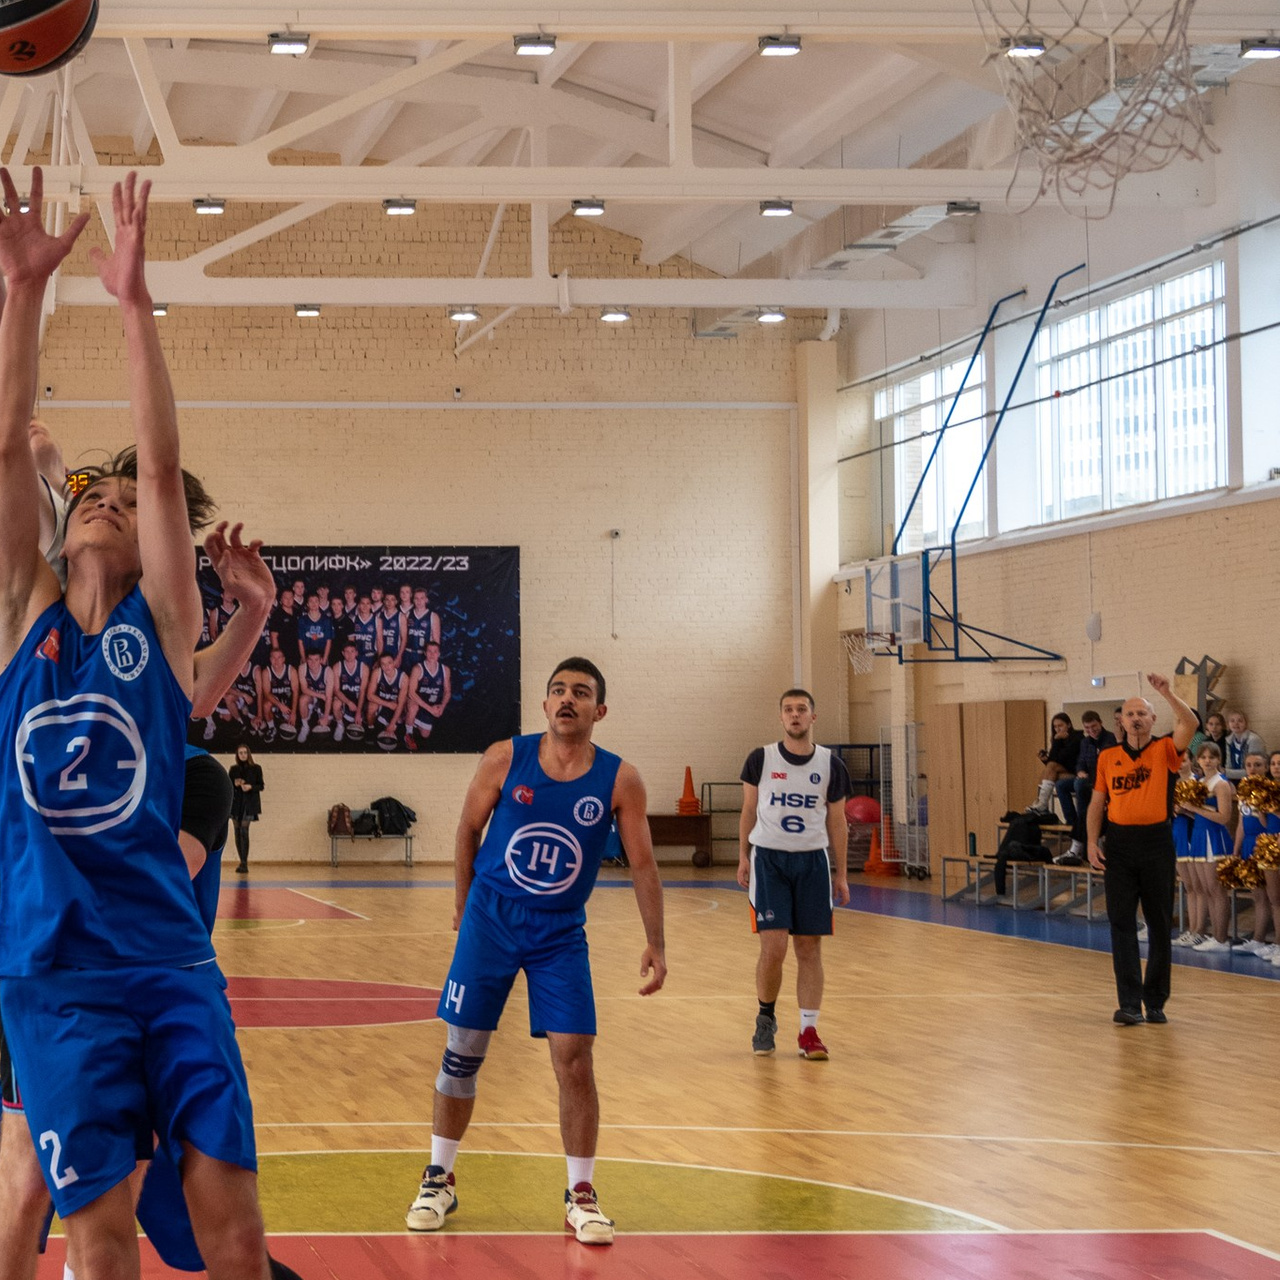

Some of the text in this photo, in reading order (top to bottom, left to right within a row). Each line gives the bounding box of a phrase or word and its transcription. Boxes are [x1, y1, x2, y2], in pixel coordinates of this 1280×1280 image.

[379, 555, 470, 570] 2022/23
[59, 736, 91, 790] 2
[770, 791, 819, 809] HSE
[781, 814, 806, 834] 6
[527, 841, 560, 876] 14
[445, 979, 466, 1014] 14
[39, 1129, 80, 1190] 2
